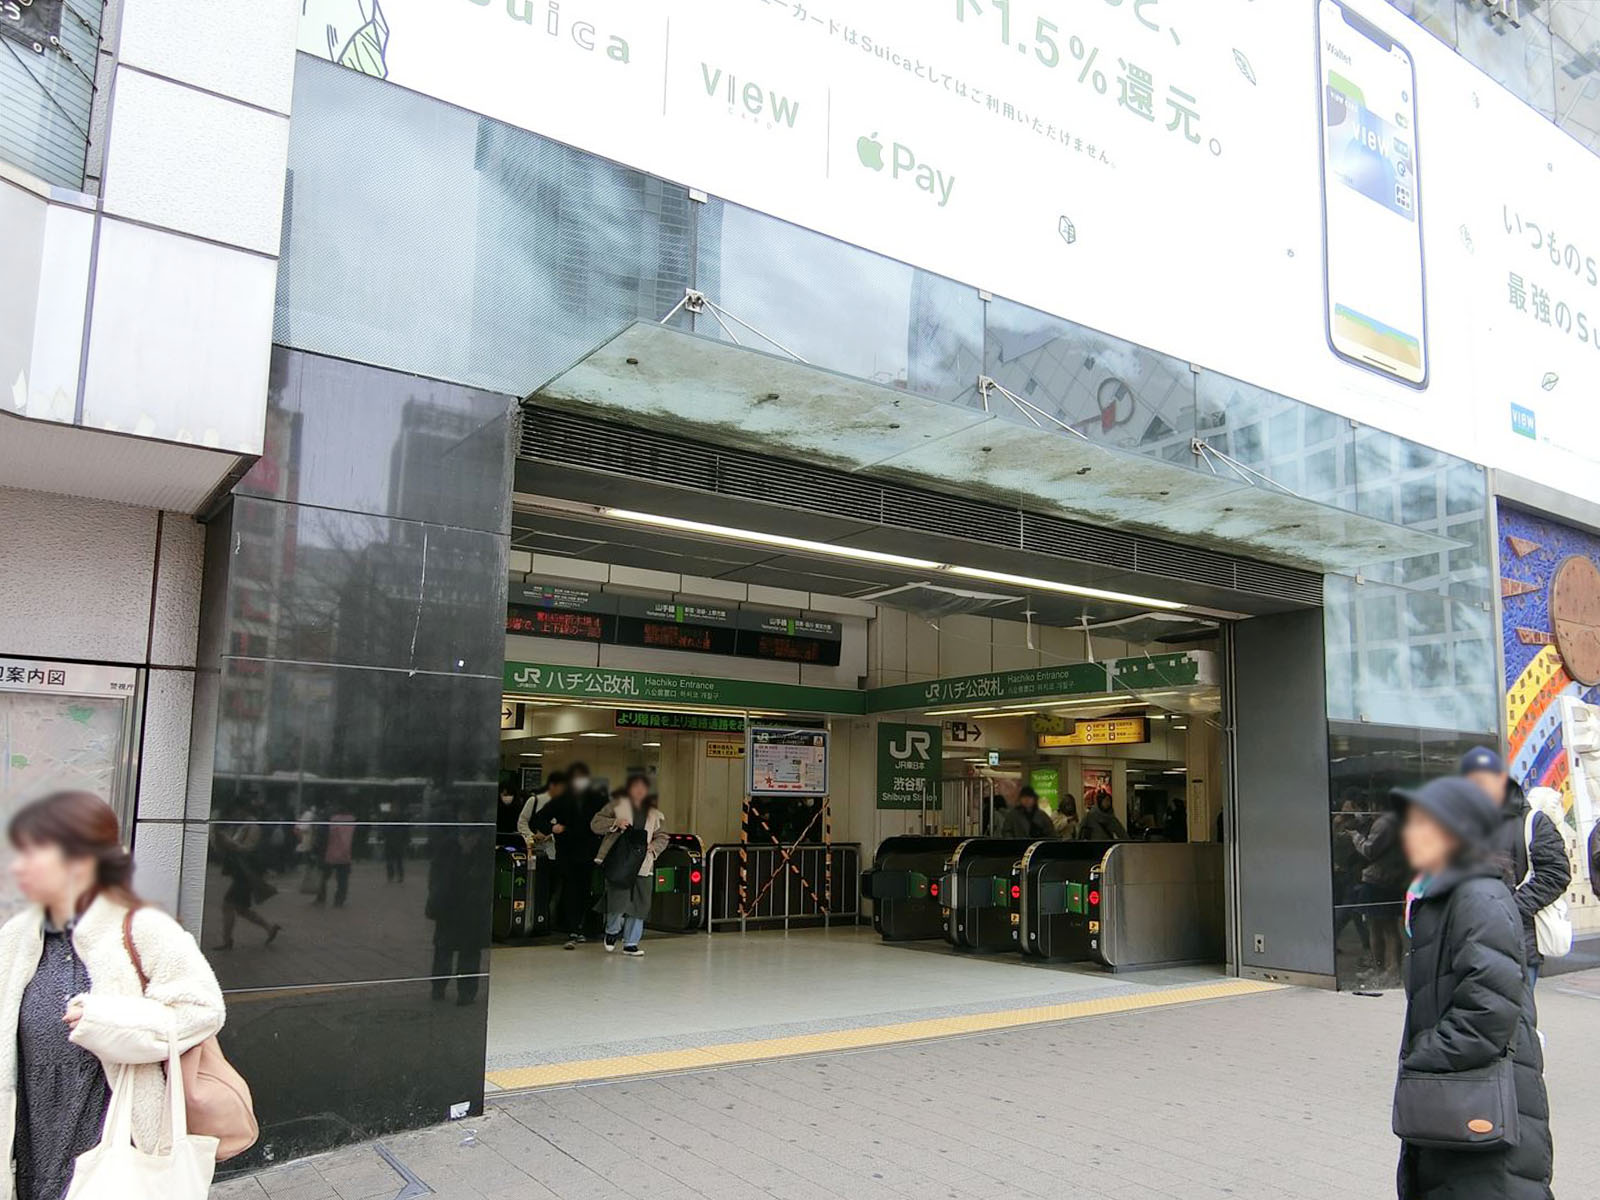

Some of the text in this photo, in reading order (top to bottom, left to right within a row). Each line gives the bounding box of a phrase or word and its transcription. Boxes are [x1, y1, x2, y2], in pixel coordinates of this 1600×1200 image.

[467, 0, 631, 65] uica
[892, 141, 956, 207] Pay
[0, 666, 66, 686] 案内図
[513, 667, 541, 684] JR
[546, 671, 640, 696] ハチ公改札
[644, 677, 715, 690] Hachiko Entrance
[1037, 671, 1070, 681] Entrance
[924, 683, 940, 699] JR
[942, 676, 1005, 700] ハチ公改札
[889, 730, 931, 760] JR
[893, 776, 927, 792] 渋谷駅
[881, 791, 911, 803] Shibuya
